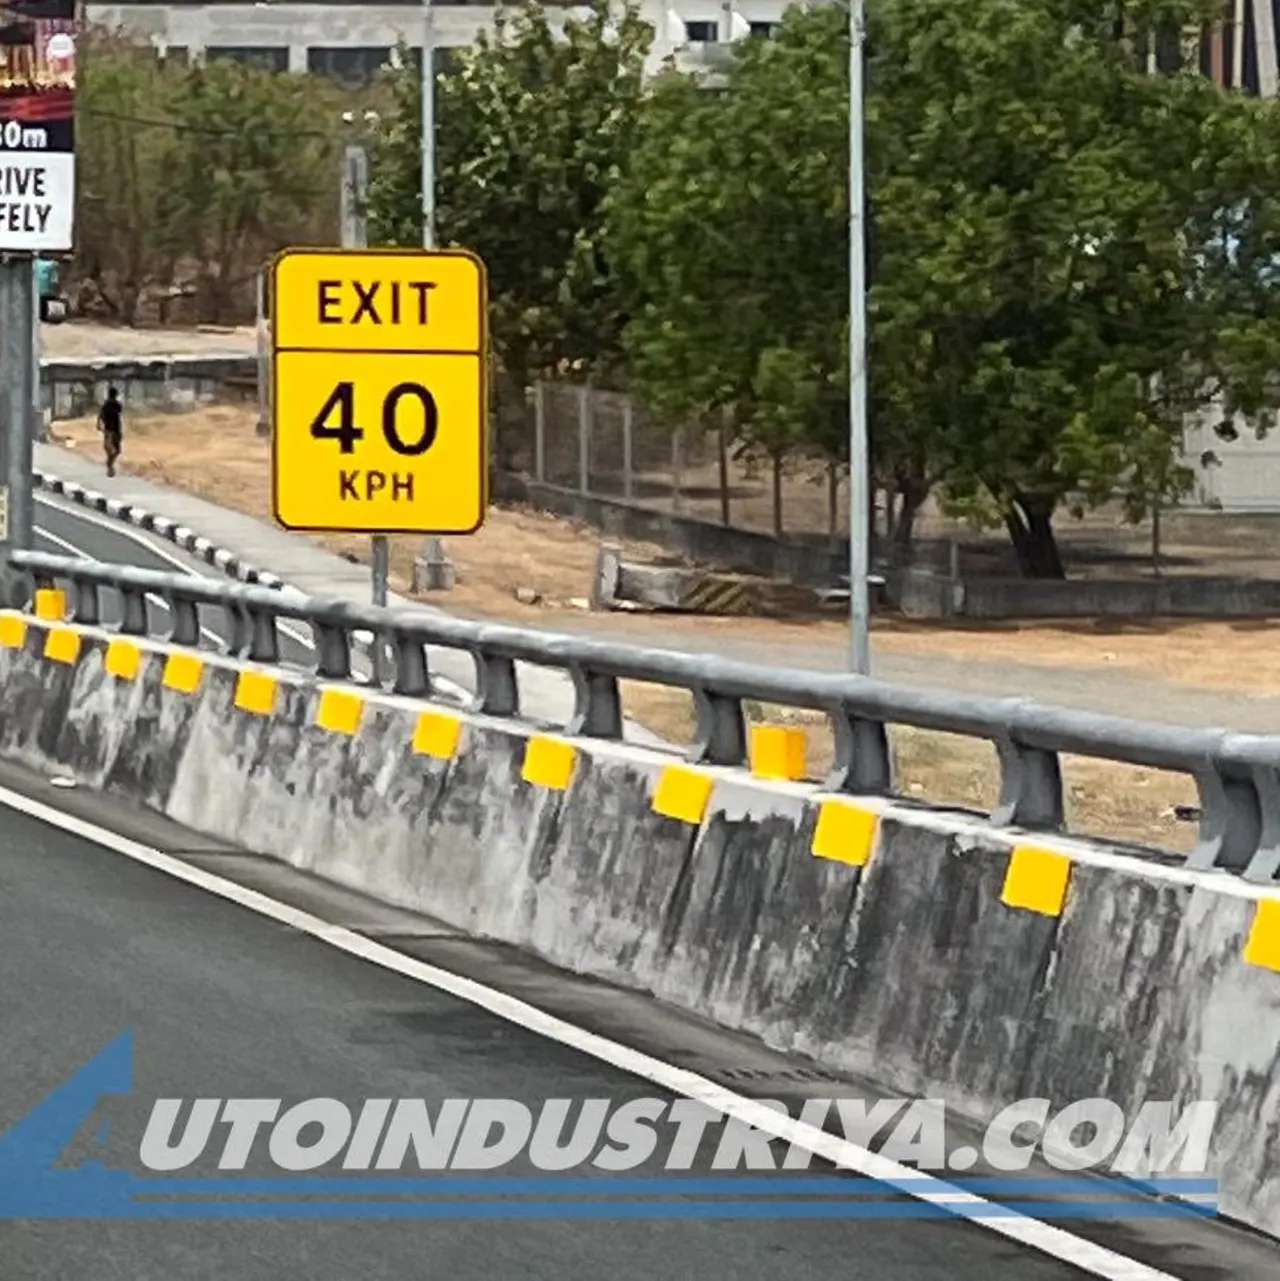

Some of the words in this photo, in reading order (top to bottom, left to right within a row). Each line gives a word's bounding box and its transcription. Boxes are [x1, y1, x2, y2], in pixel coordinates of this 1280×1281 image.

[317, 280, 438, 325] EXIT
[309, 381, 439, 457] 40
[339, 470, 415, 502] KPH
